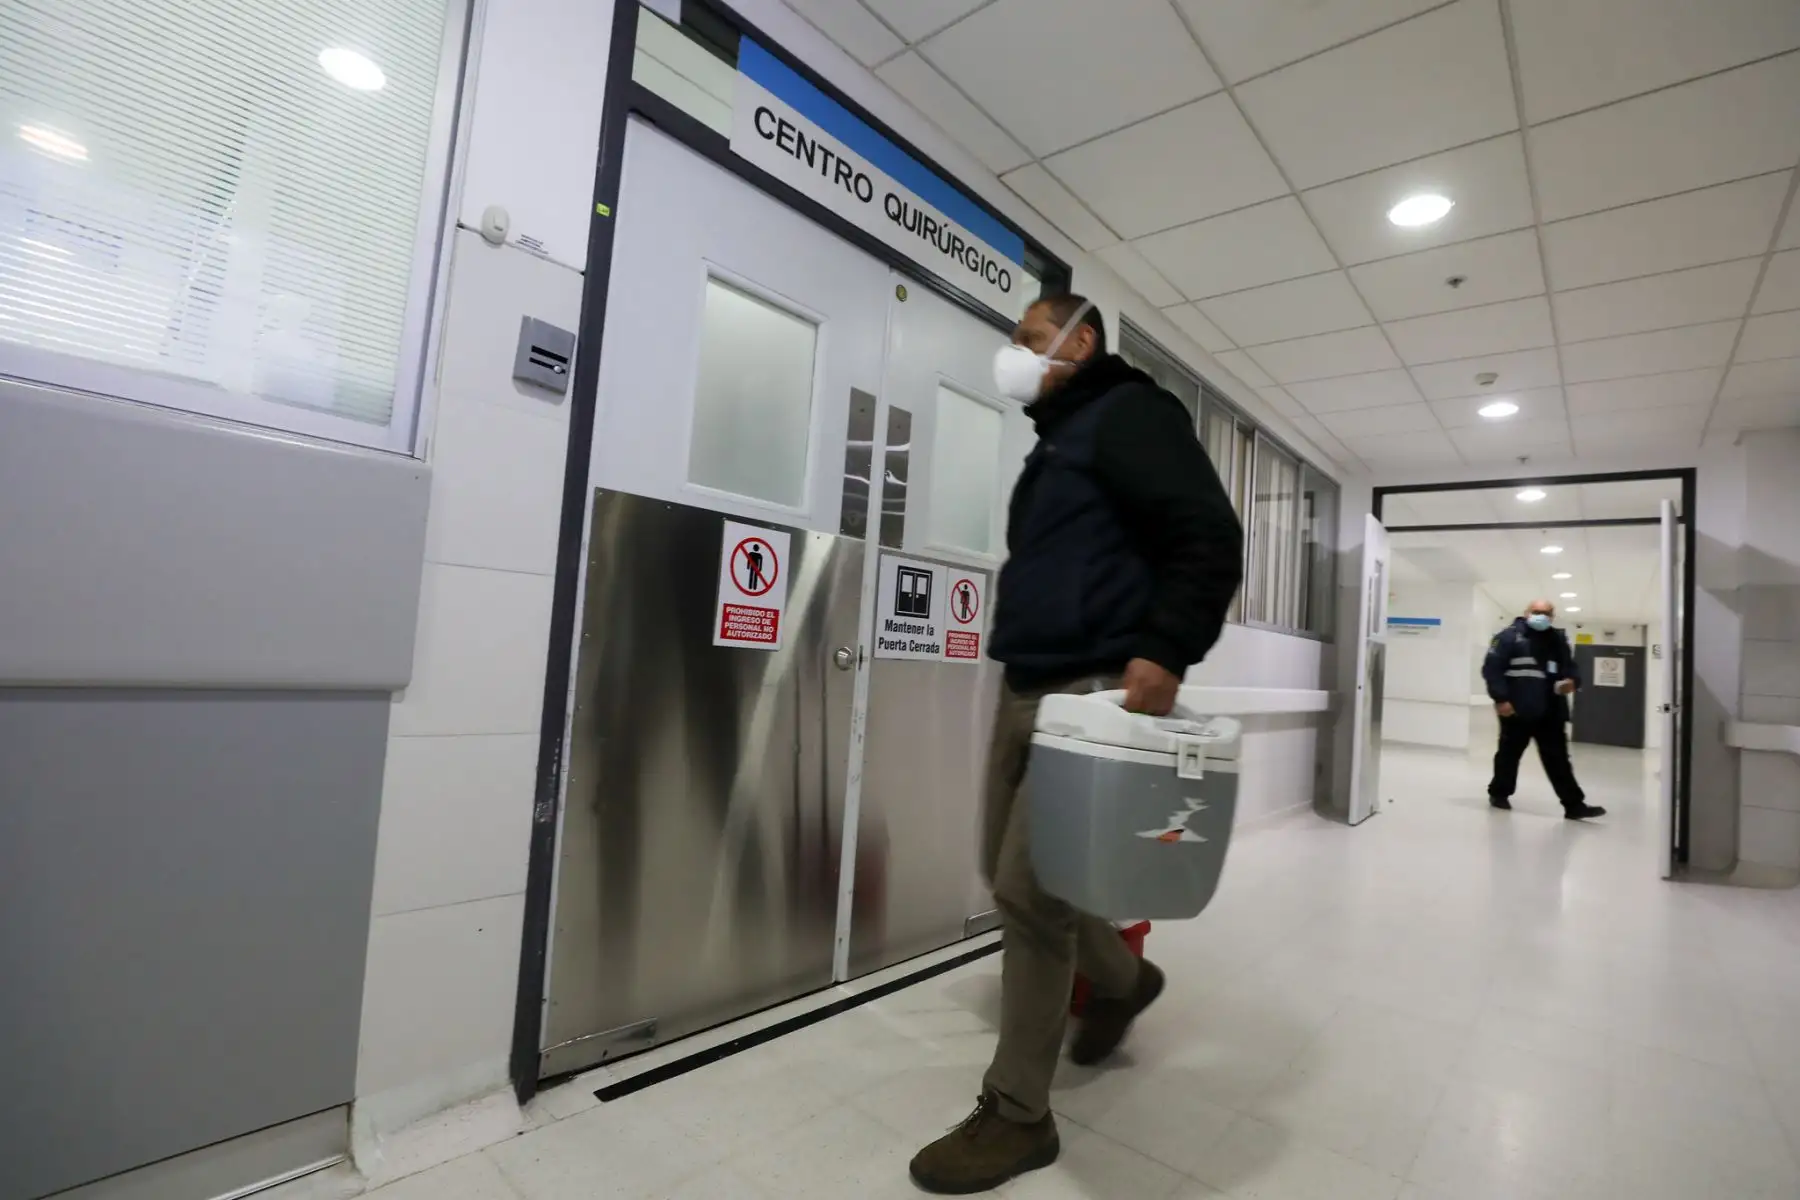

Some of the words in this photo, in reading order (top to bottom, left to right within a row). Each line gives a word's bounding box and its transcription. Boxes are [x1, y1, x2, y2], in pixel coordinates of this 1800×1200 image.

[754, 106, 873, 203] CENTRO
[884, 192, 1011, 293] QUIRÚRGICO
[726, 607, 765, 617] PROHIBIDO
[728, 614, 760, 624] INGRESO
[725, 622, 762, 631] PERSONAL
[885, 619, 925, 635] Mantener
[926, 624, 934, 636] la
[727, 630, 772, 639] AUTORIZADO
[878, 636, 907, 651] Puerta
[909, 640, 940, 654] Cerrada
